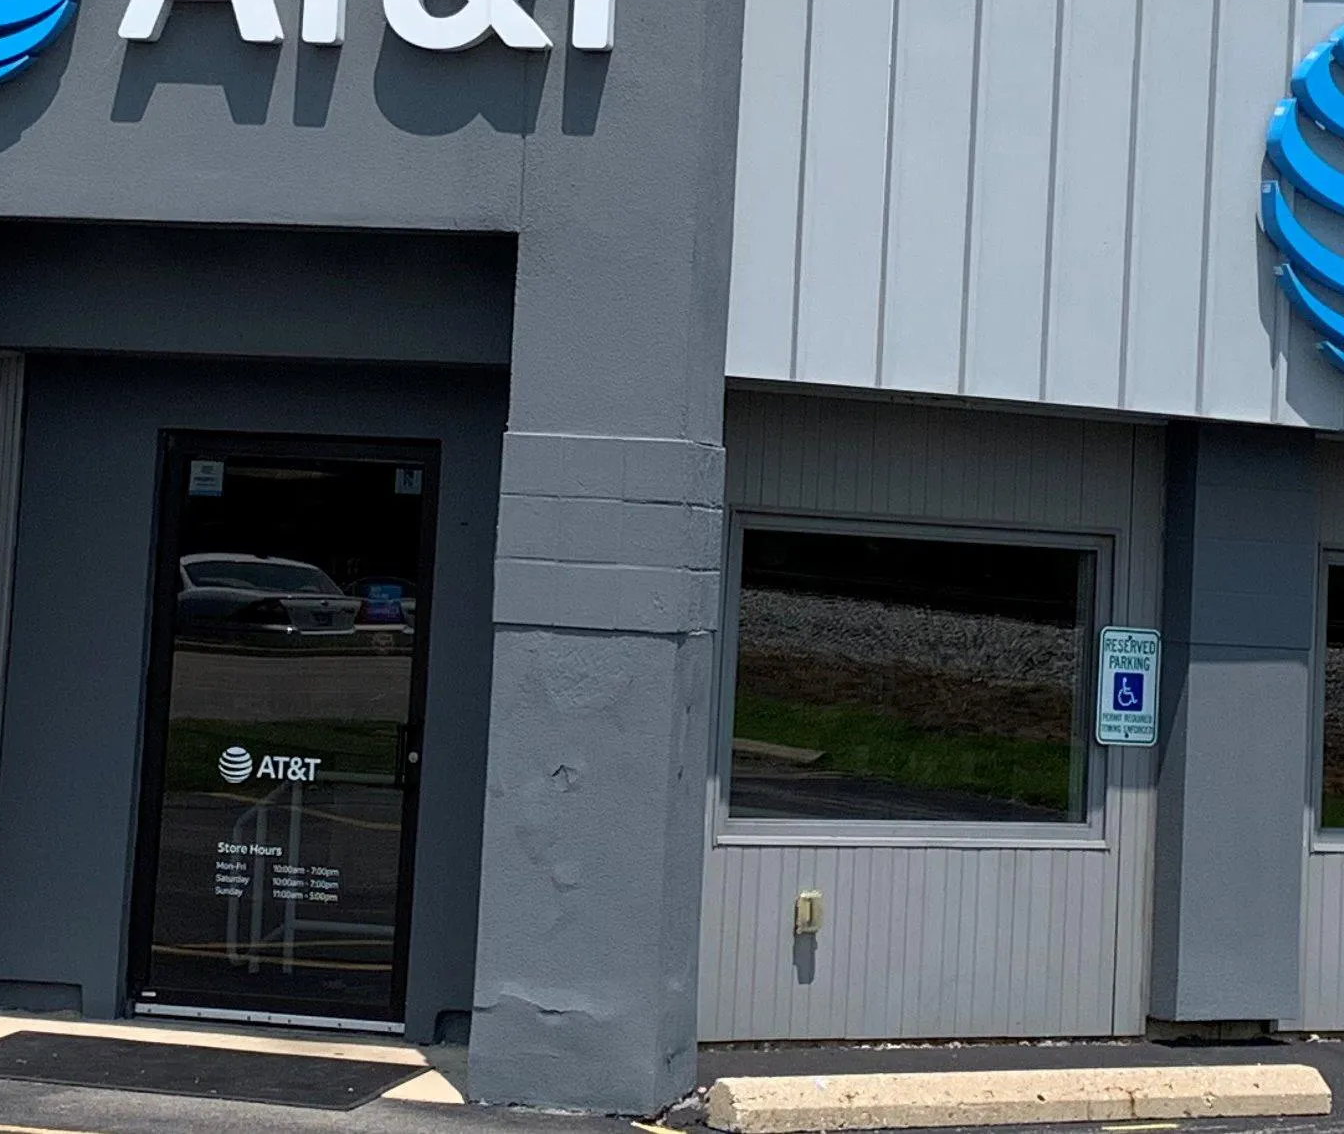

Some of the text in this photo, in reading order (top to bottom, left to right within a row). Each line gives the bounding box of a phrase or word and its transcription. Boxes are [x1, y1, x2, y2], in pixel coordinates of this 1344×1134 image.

[1104, 638, 1156, 655] RESERVED
[1109, 655, 1150, 671] PARKING
[257, 755, 322, 781] AT&T
[217, 842, 282, 856] Store Hours
[216, 861, 246, 870] Mon-Fri
[216, 874, 250, 885] Saturday
[273, 877, 304, 886] 10:00am
[215, 886, 243, 897] Sunday
